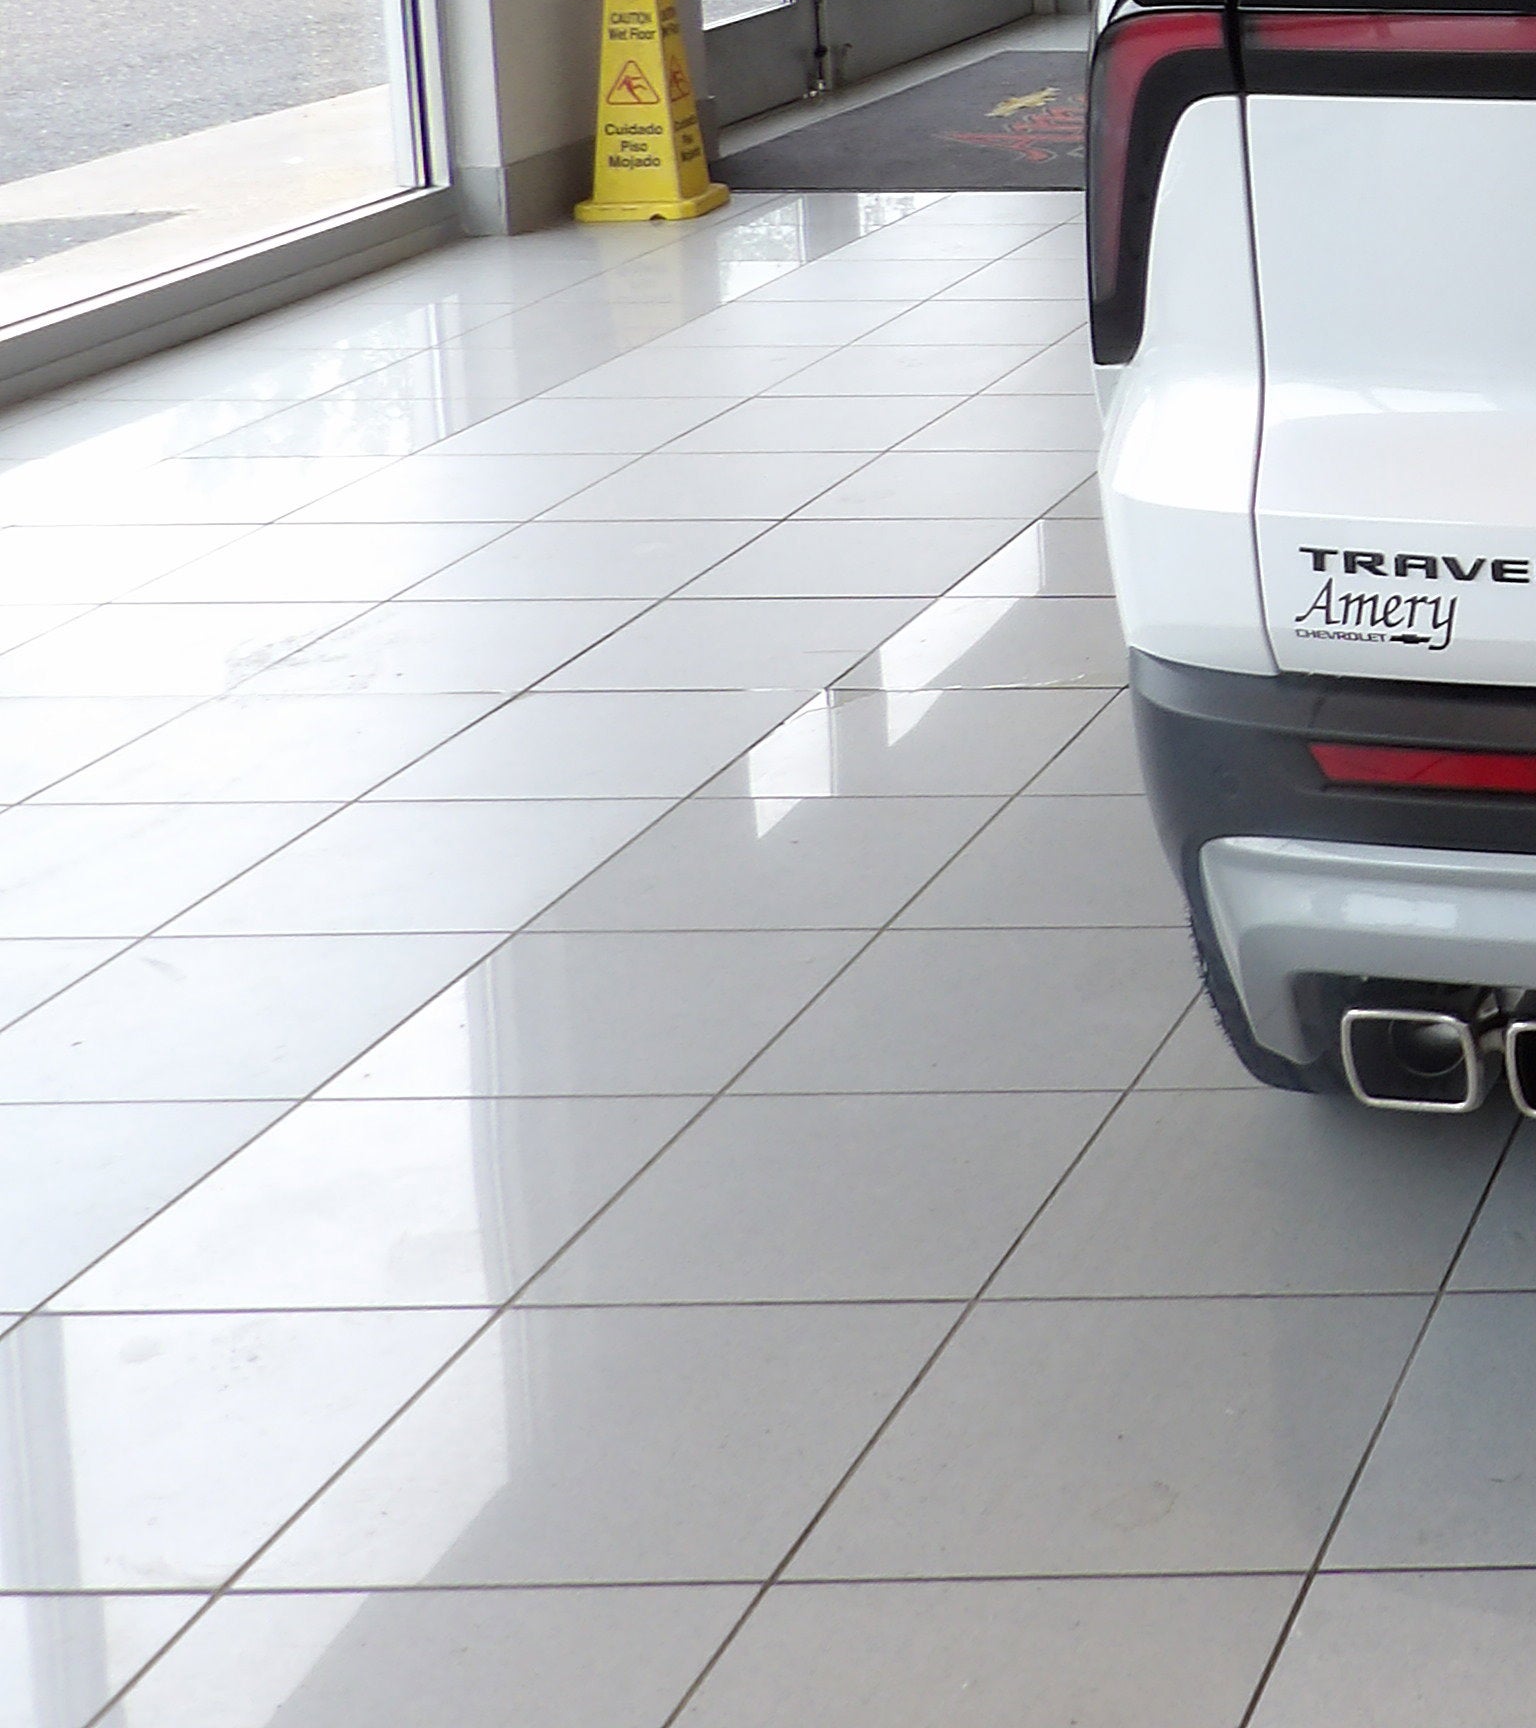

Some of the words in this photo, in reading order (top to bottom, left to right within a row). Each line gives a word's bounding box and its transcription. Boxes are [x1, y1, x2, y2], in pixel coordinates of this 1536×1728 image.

[608, 28, 628, 40] Wet
[630, 28, 656, 40] Floor
[604, 123, 664, 136] Cuidado
[620, 140, 648, 152] Piso
[608, 155, 661, 170] Mojado
[1294, 577, 1459, 651] Amery
[1294, 629, 1387, 643] CHEVROLET
